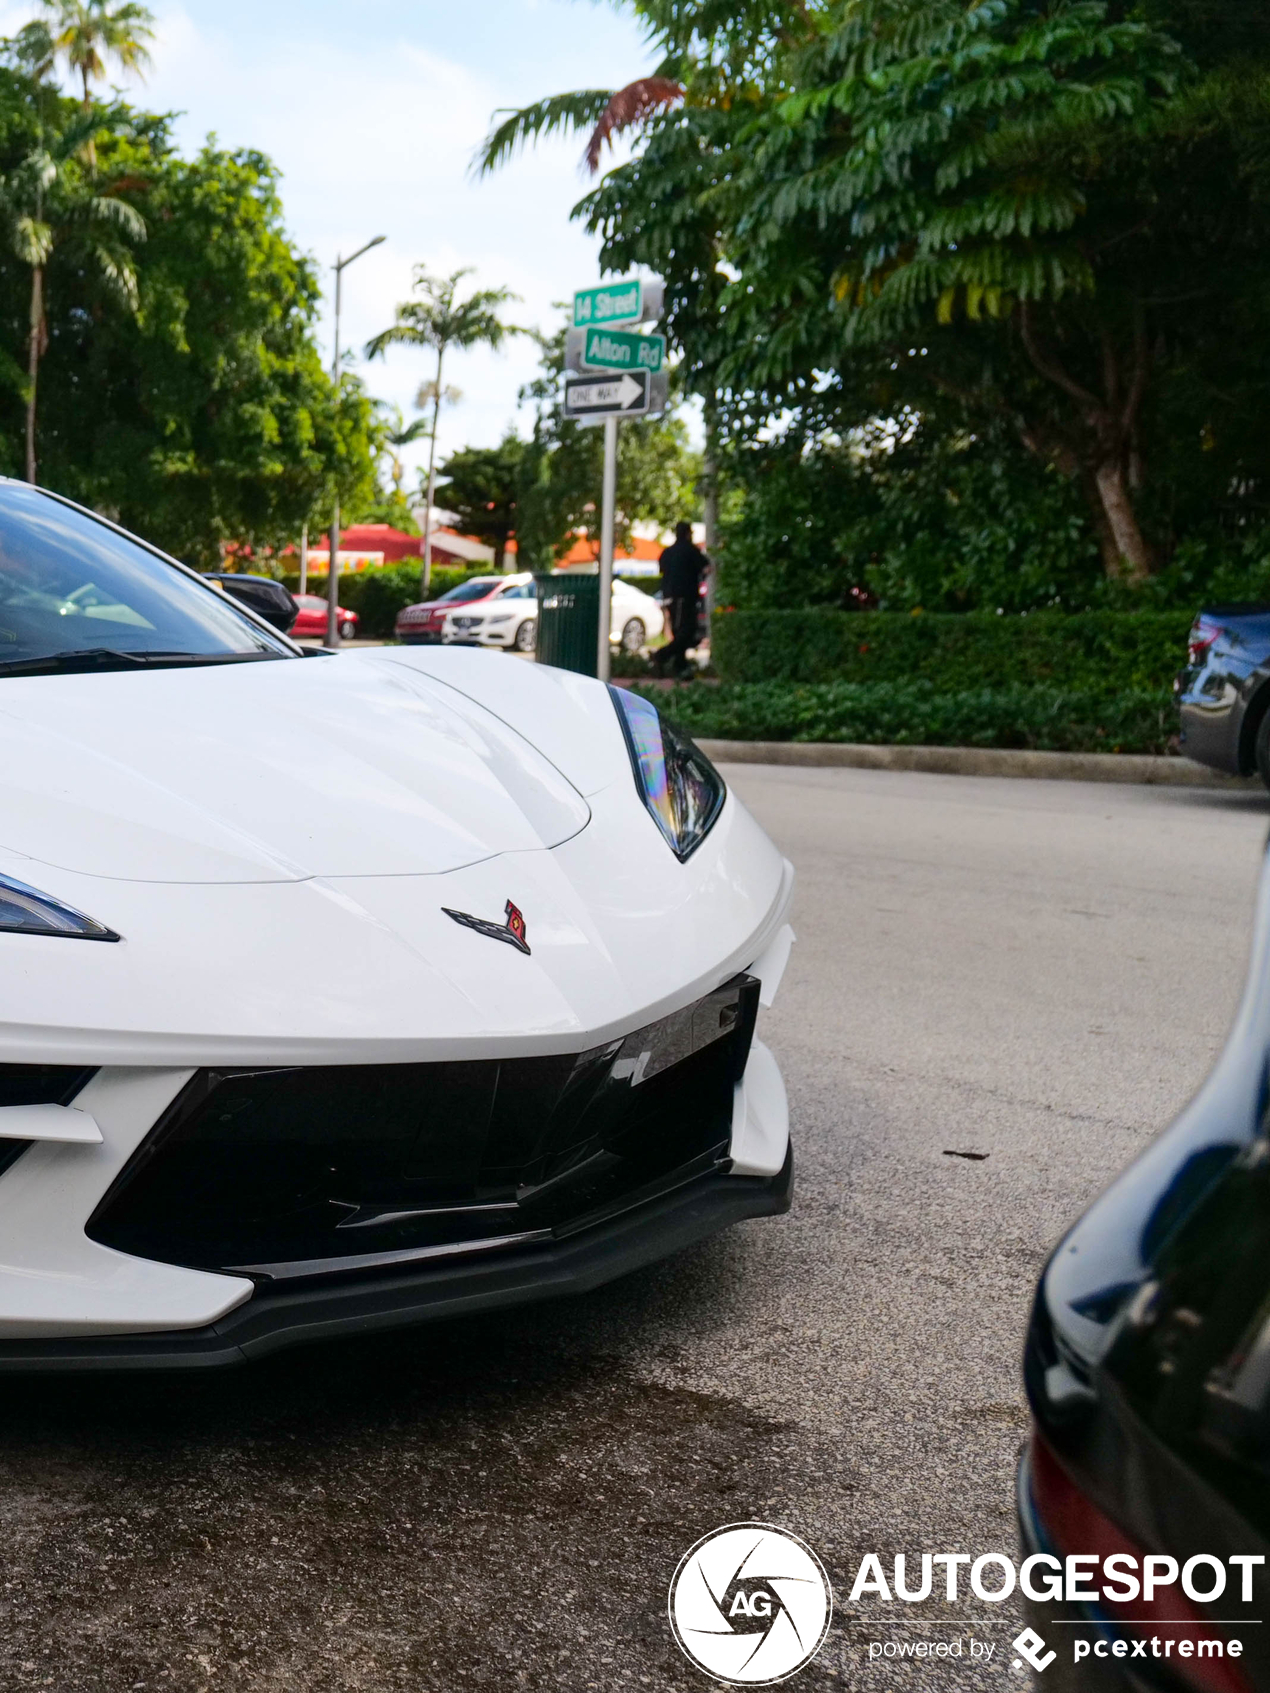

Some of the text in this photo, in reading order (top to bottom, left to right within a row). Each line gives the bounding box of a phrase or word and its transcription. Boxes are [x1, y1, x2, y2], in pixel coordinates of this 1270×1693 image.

[576, 288, 637, 320] 14 Street
[588, 335, 660, 367] Alton Rd
